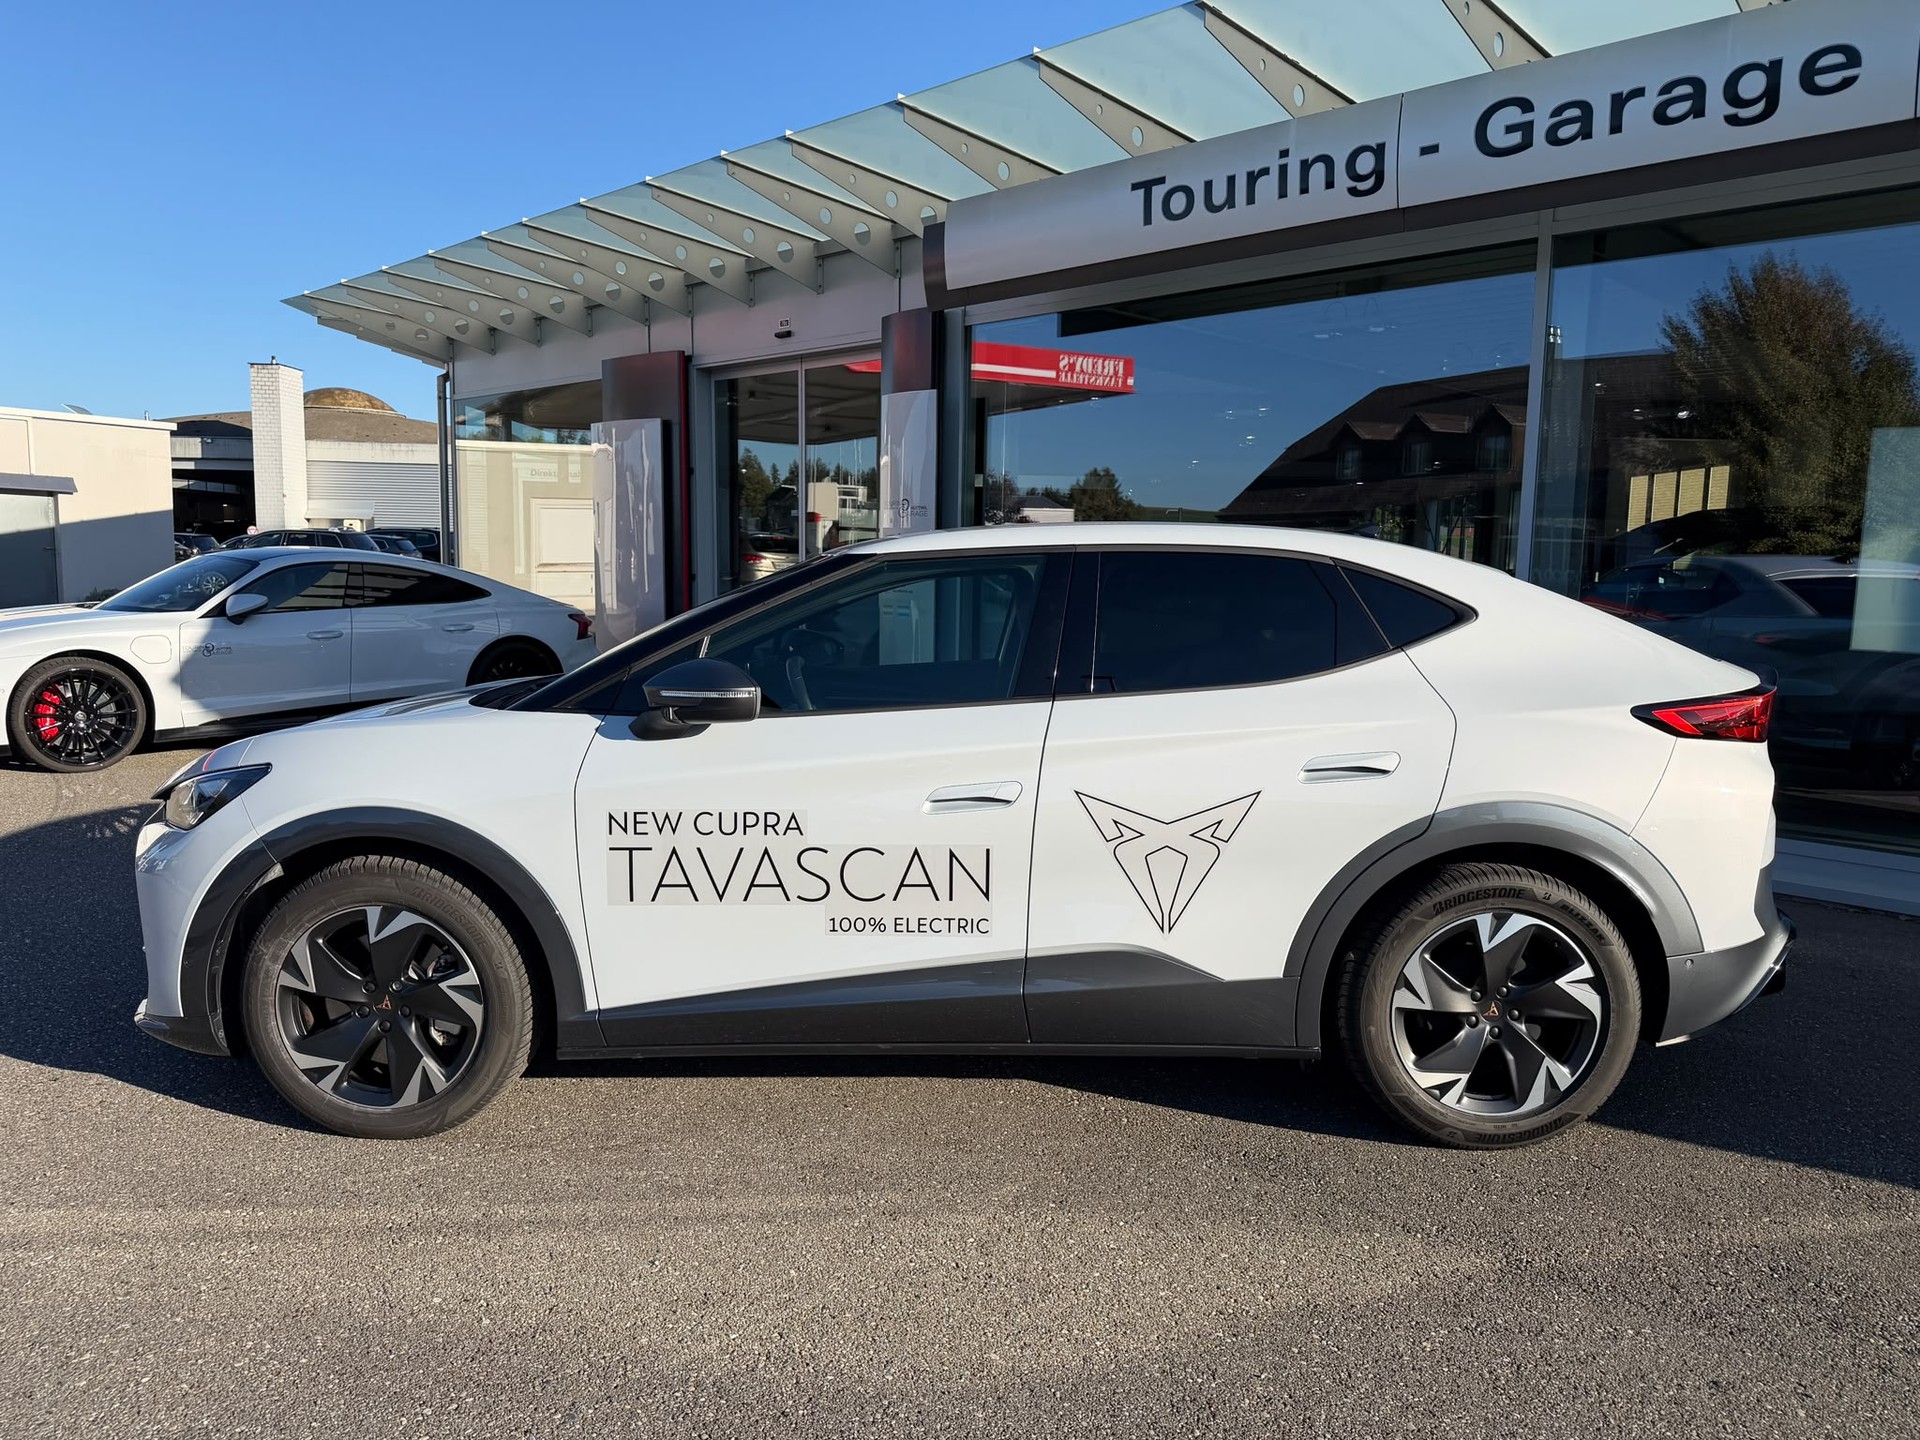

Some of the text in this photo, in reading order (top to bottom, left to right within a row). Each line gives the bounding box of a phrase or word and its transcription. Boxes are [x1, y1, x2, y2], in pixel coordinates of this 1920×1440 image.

[1130, 141, 1387, 226] Touring
[1474, 43, 1863, 158] Garage
[608, 811, 804, 836] NEW CUPRA
[608, 845, 991, 903] TAVASCAN
[1432, 887, 1526, 915] BRIDGESTONE
[829, 916, 990, 935] 100% ELECTRIC
